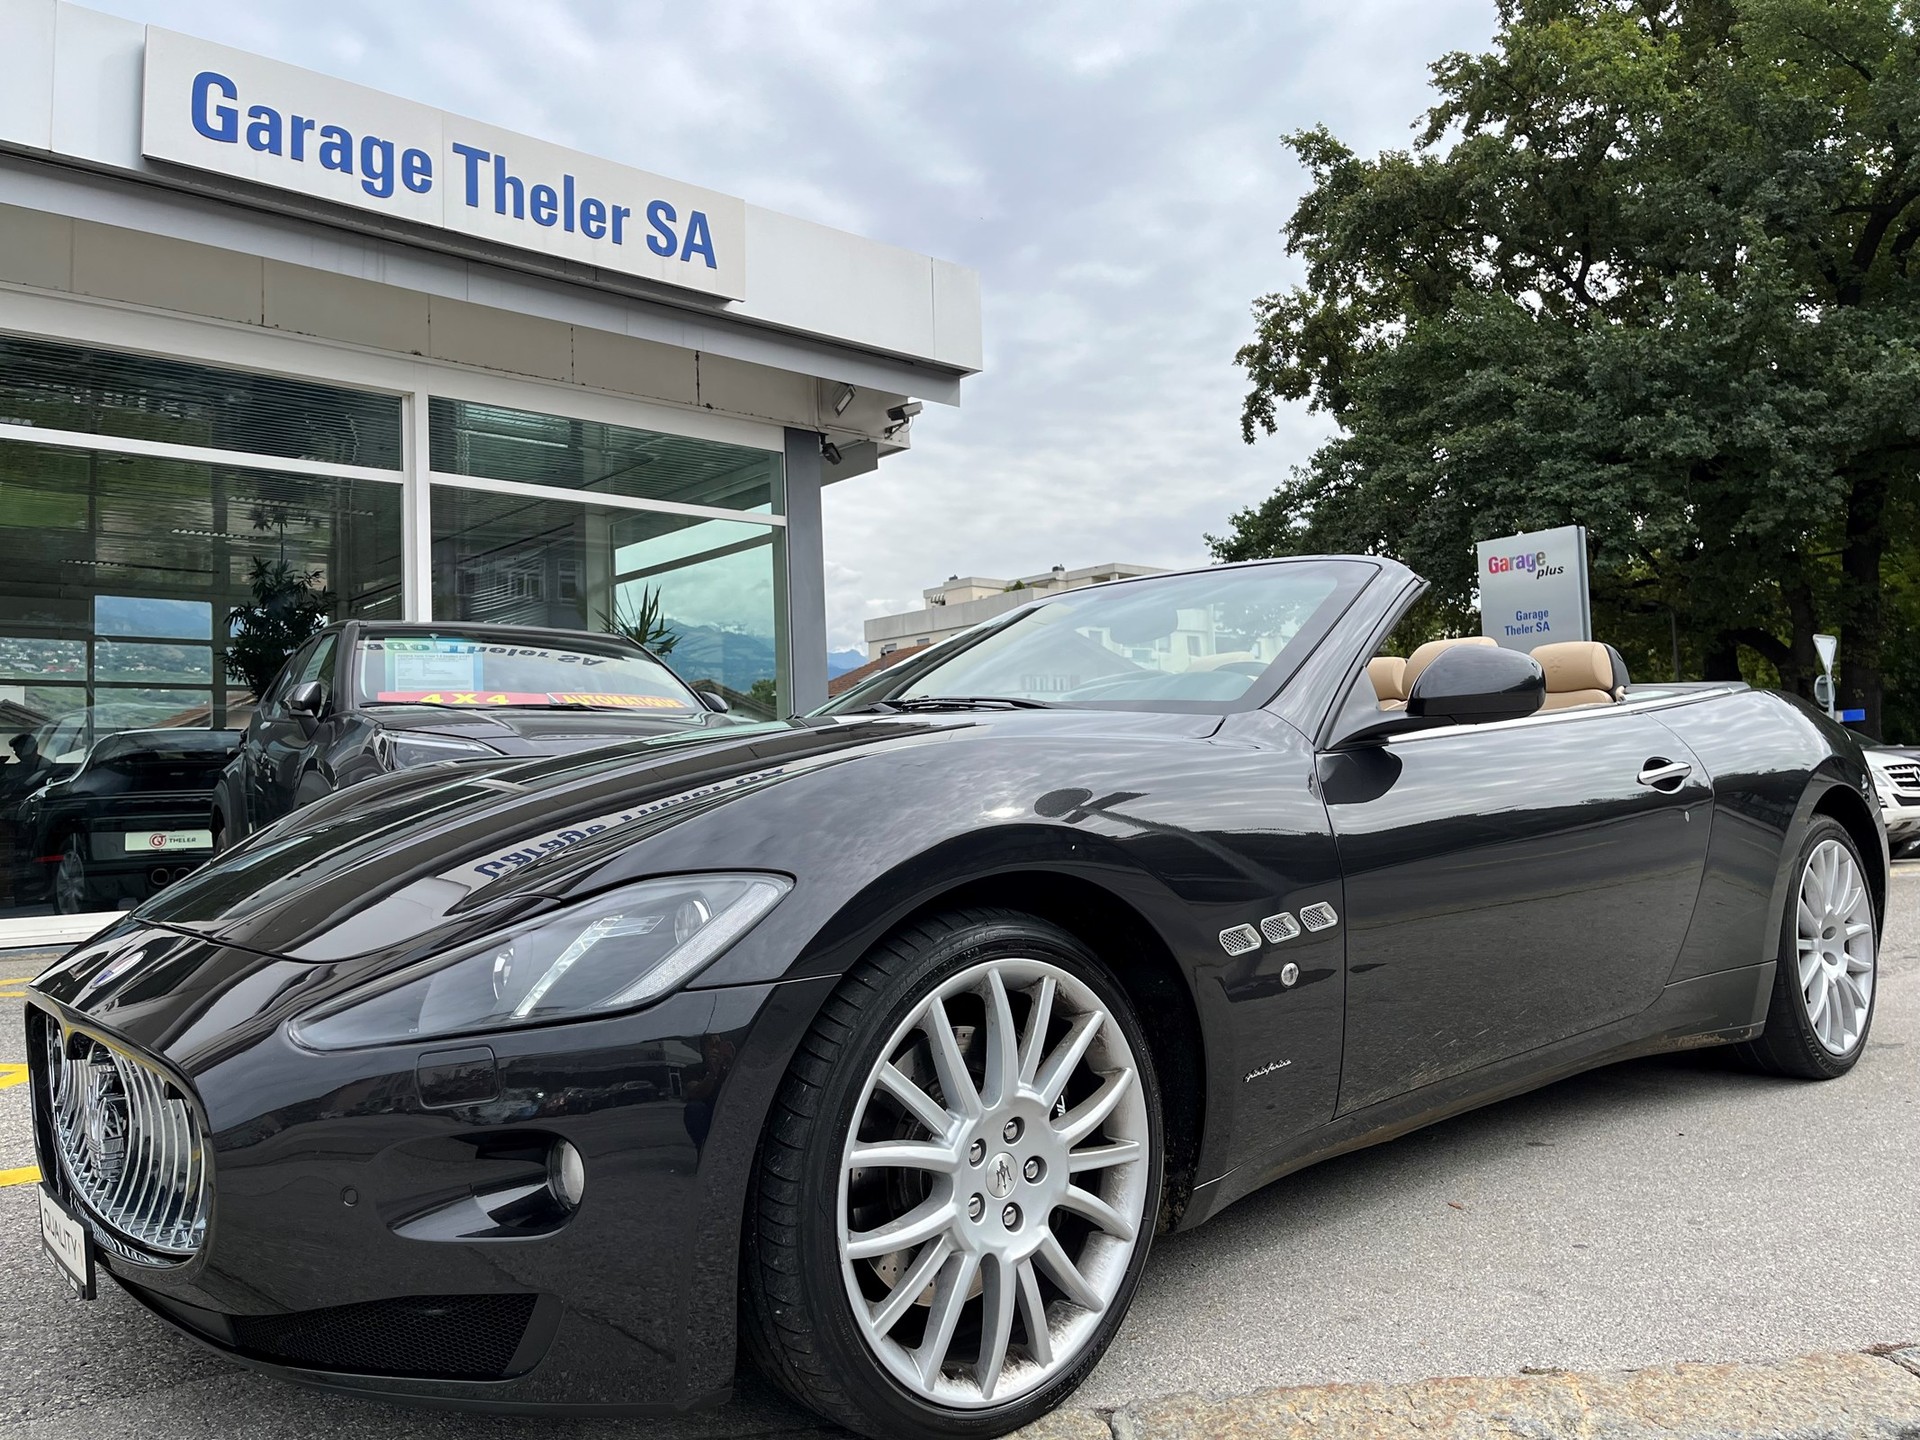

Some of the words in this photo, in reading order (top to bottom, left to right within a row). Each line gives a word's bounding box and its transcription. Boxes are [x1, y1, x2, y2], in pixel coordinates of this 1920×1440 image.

[190, 71, 434, 199] Garage
[452, 142, 631, 245] Theler
[646, 199, 717, 269] SA
[1488, 551, 1546, 574] Garage
[1536, 565, 1565, 580] plus
[1516, 610, 1548, 621] Garage
[1505, 625, 1533, 636] Theler
[1536, 621, 1550, 632] SA
